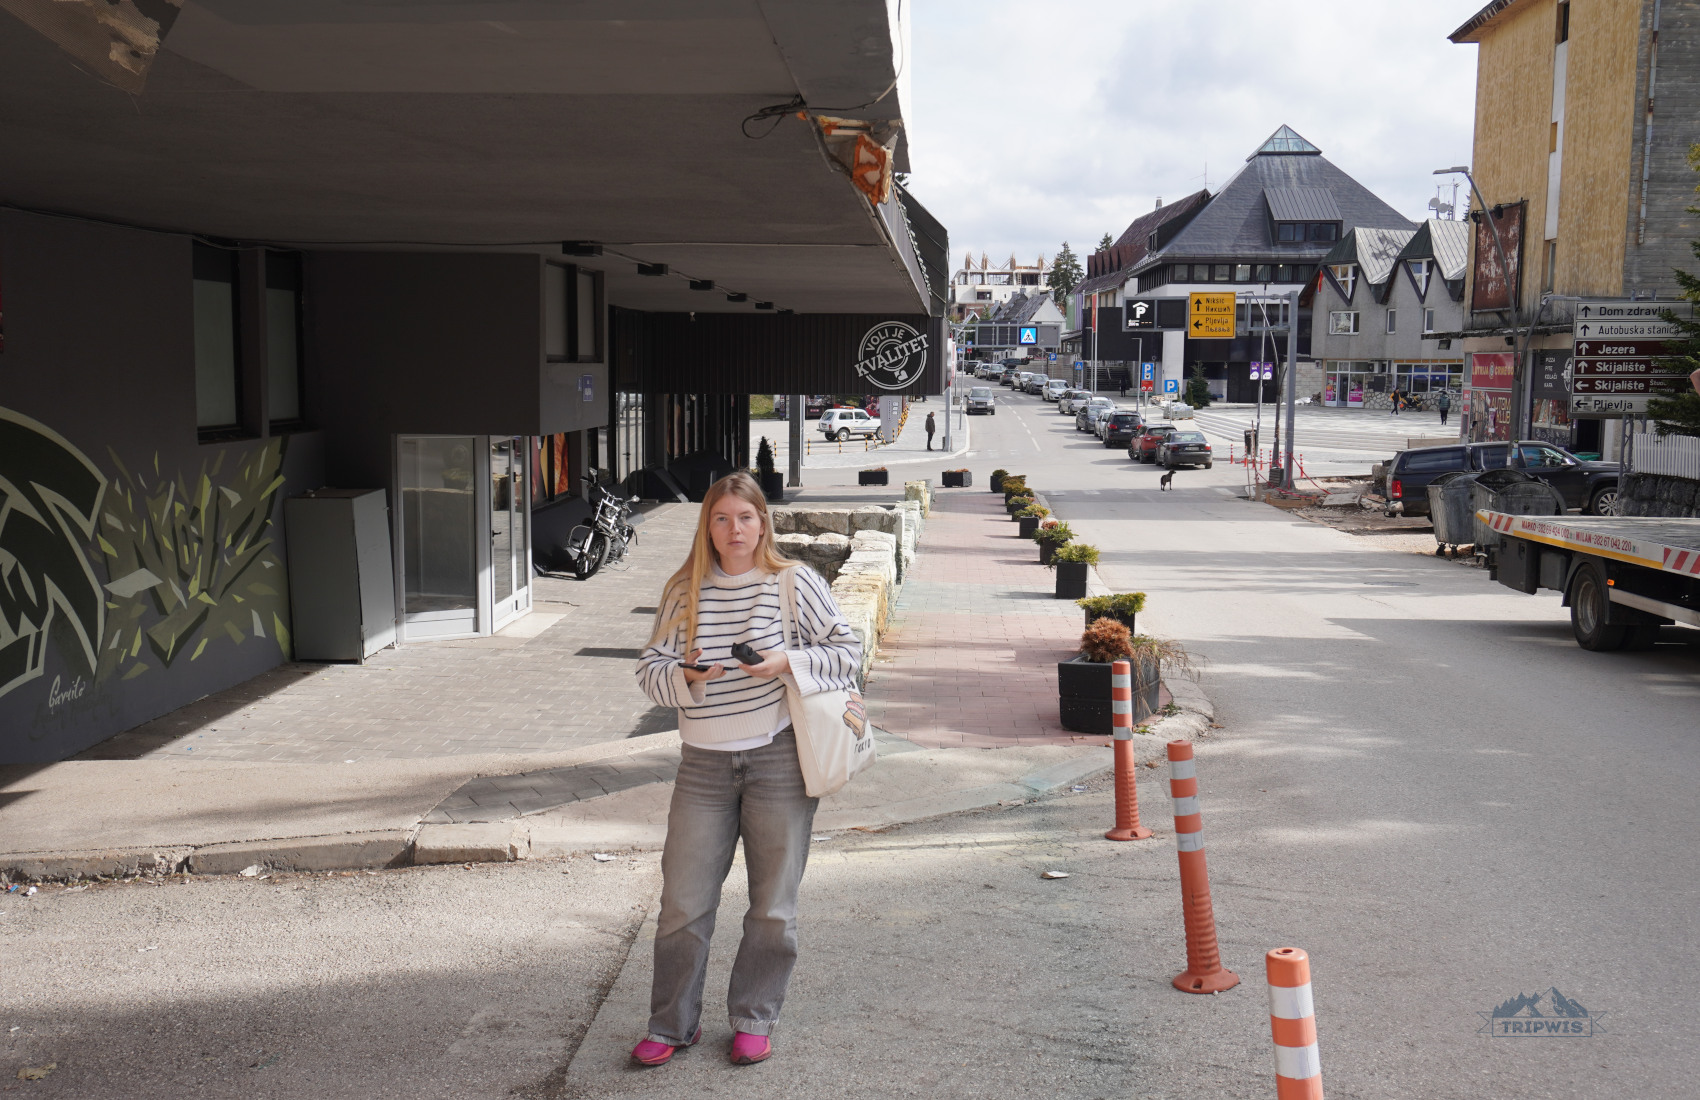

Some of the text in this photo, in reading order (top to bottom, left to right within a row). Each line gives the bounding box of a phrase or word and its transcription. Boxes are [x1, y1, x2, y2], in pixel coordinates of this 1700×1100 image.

[1599, 307, 1623, 316] Dom
[1206, 317, 1228, 325] Pljevlja
[1598, 325, 1645, 335] Autobuska
[865, 327, 905, 351] VOLI JE
[1598, 344, 1636, 354] Jezera
[854, 333, 929, 377] KVALITET
[1596, 361, 1646, 374] Skijalište
[1594, 380, 1645, 392] Skijalište
[1593, 400, 1633, 412] Pljevlja
[1621, 541, 1632, 552] 220
